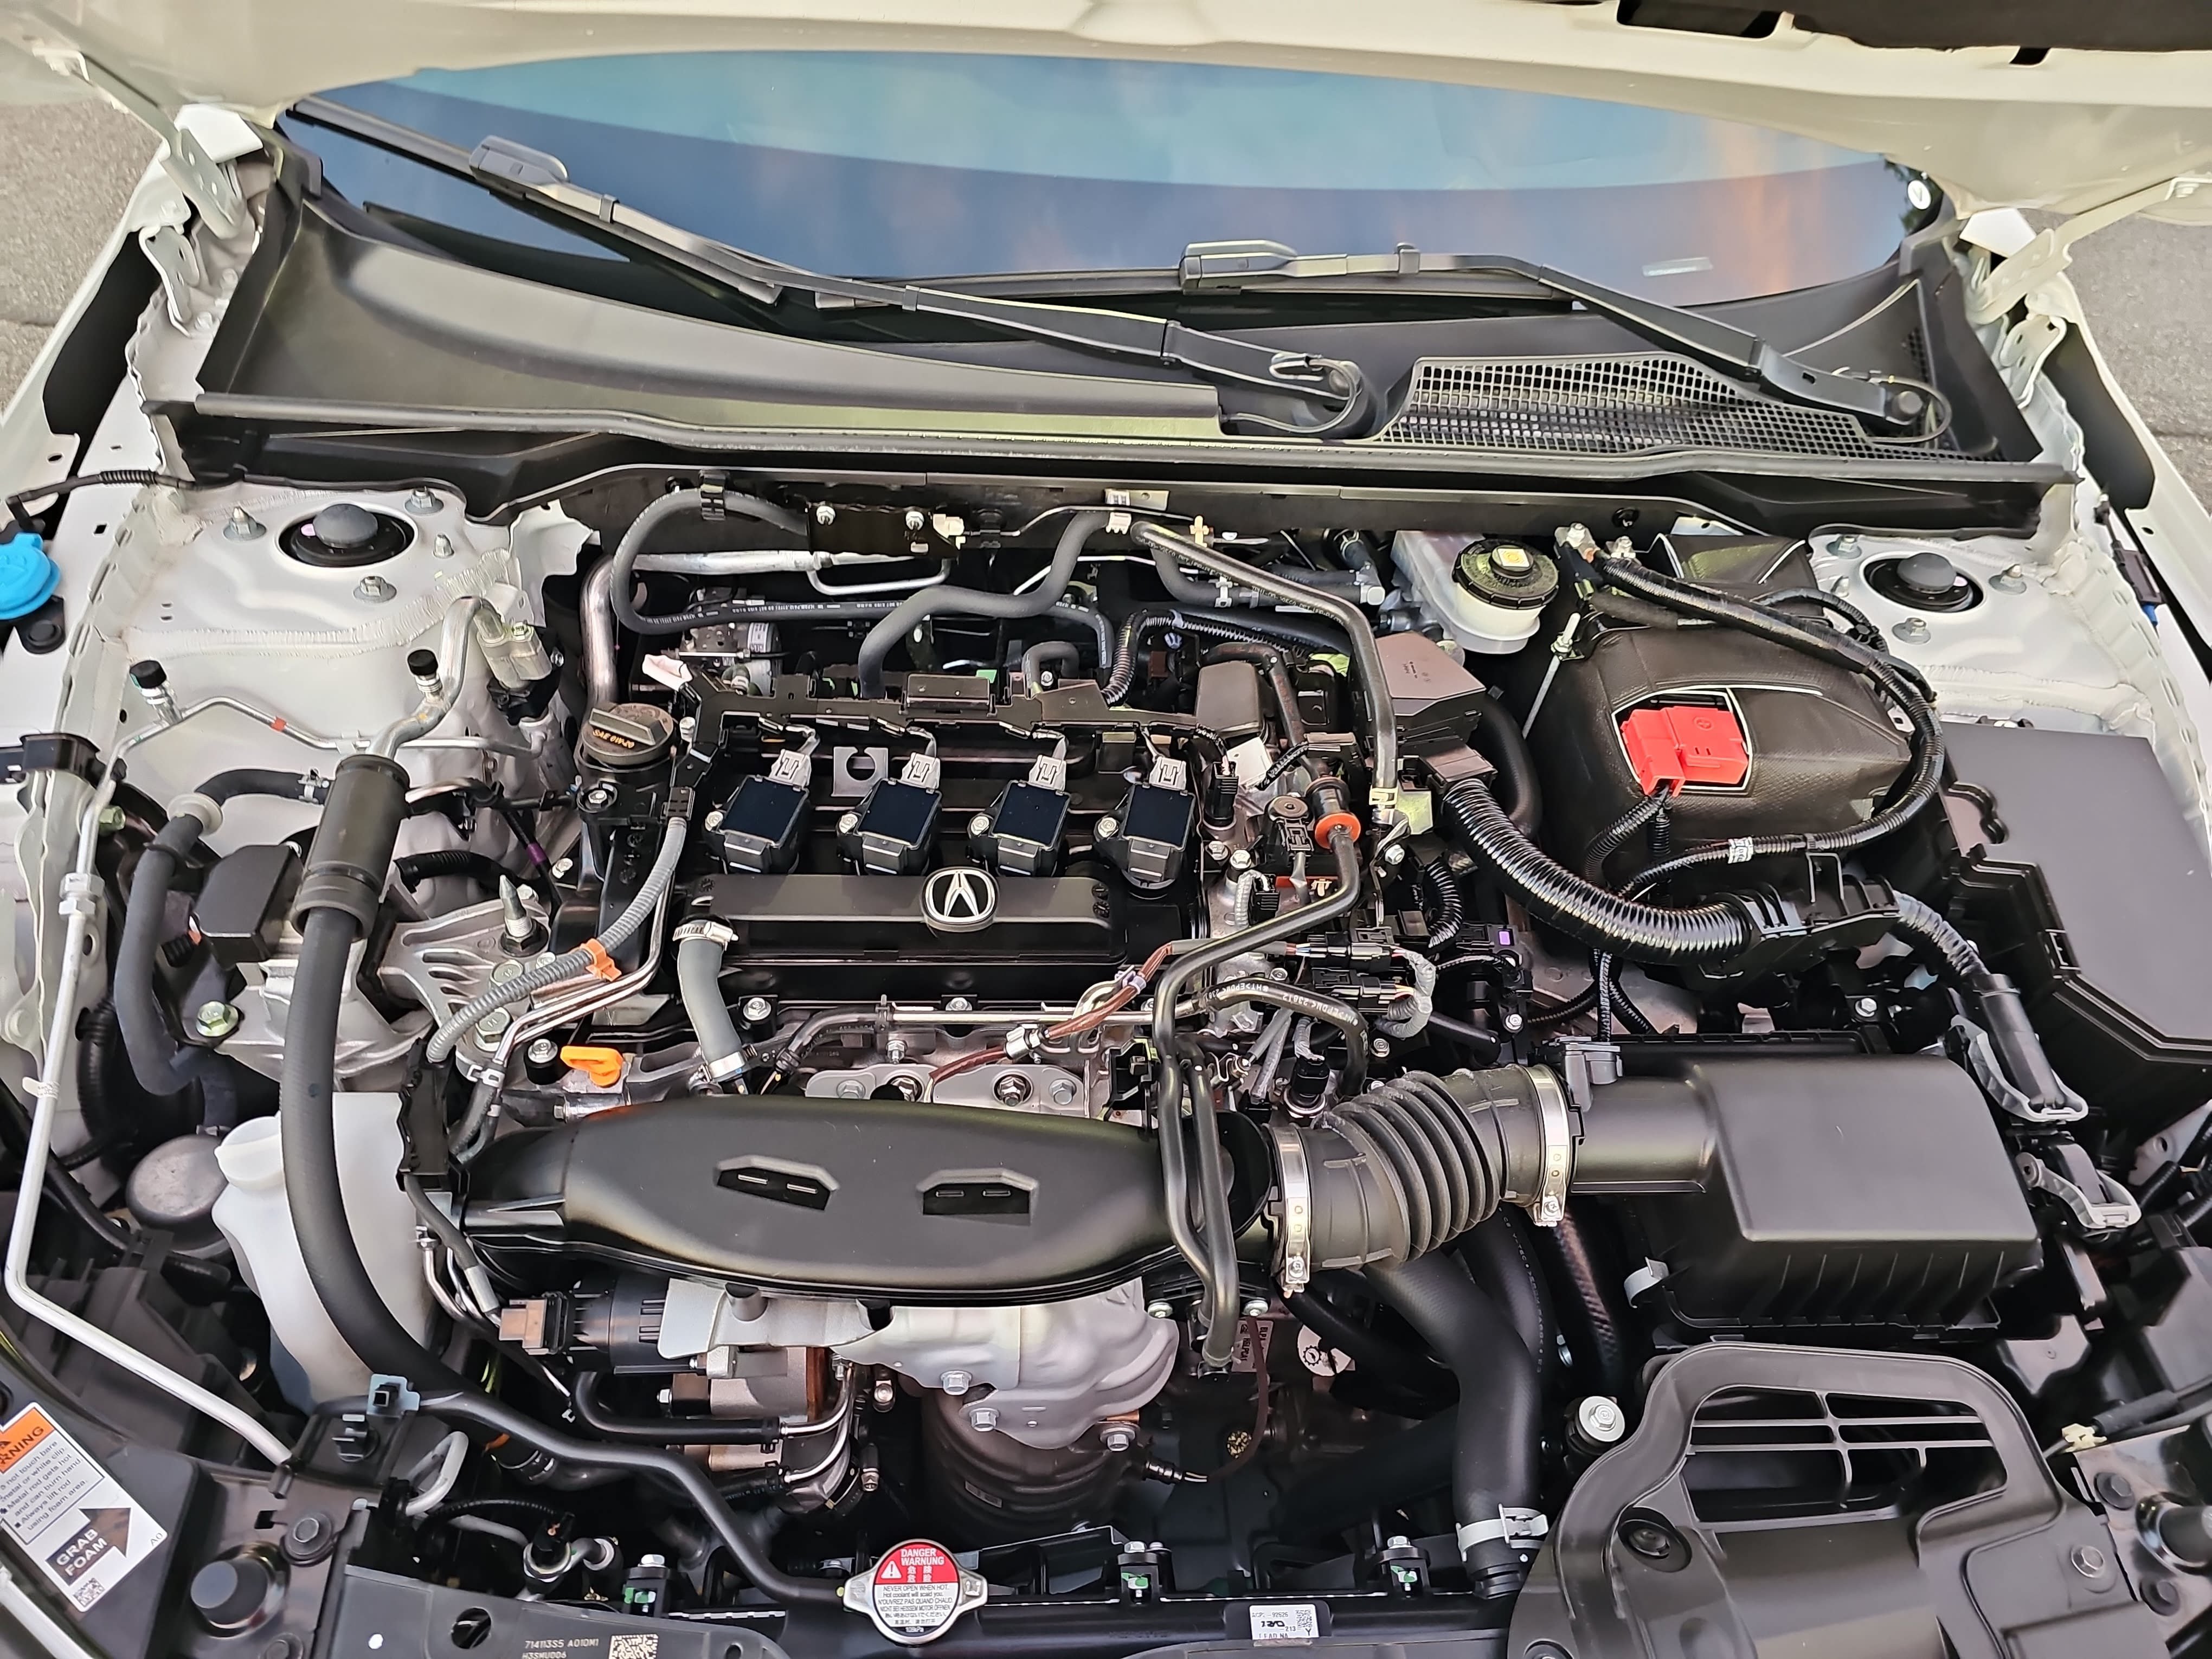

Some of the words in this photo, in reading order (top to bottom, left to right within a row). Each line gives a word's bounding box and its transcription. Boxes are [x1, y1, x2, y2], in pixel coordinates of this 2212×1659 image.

[593, 729, 611, 740] SAE
[610, 735, 635, 749] 0W-20
[0, 1426, 44, 1464] RNING
[6, 1472, 19, 1484] not
[20, 1455, 40, 1474] touch
[41, 1441, 57, 1456] bare
[8, 1490, 29, 1508] Metal
[29, 1478, 42, 1490] rod
[42, 1464, 59, 1480] gets
[60, 1454, 72, 1465] hot
[14, 1502, 29, 1516] and
[30, 1490, 44, 1503] can
[44, 1474, 61, 1490] burn
[62, 1456, 83, 1475] hand.
[31, 1458, 51, 1476] white
[21, 1500, 49, 1523] Always
[48, 1490, 58, 1500] lift
[58, 1479, 70, 1491] rod
[28, 1512, 49, 1530] using
[49, 1495, 68, 1513] foam
[69, 1478, 88, 1495] area.
[56, 1528, 99, 1566] GRAB
[64, 1537, 108, 1577] FOAM
[901, 1548, 937, 1558] DANGER
[901, 1556, 945, 1566] WARNUNG
[1305, 1628, 1311, 1636] Y
